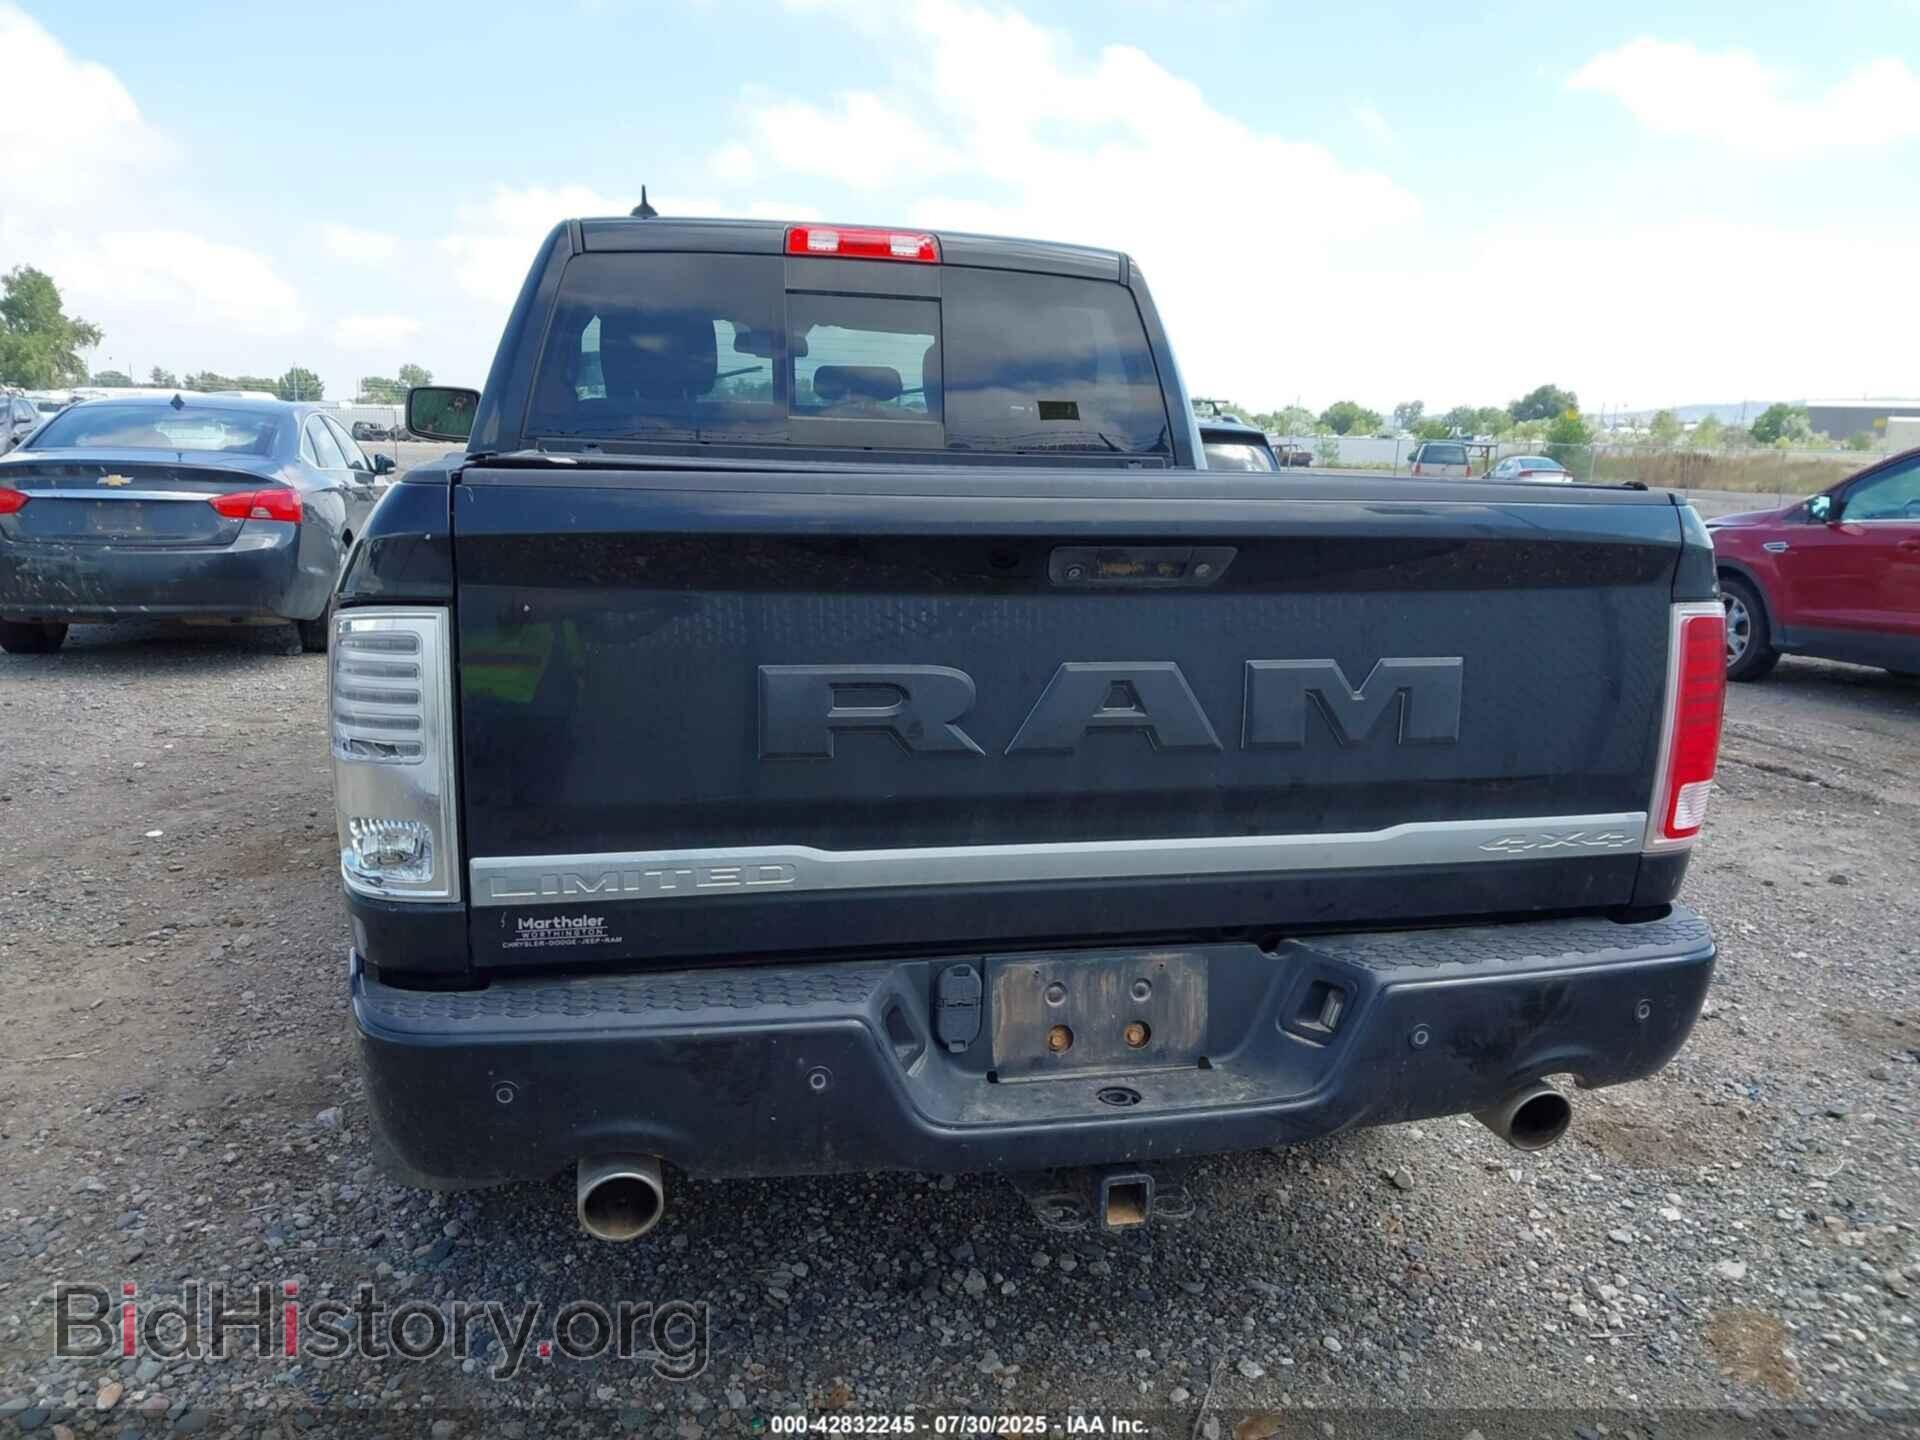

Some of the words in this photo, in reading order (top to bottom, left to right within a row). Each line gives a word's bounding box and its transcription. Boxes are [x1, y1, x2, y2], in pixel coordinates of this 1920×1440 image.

[758, 656, 1464, 760] RAM
[490, 863, 797, 897] LIMITED
[517, 914, 605, 930] Marthaler
[521, 928, 603, 938] WORTHINGTON
